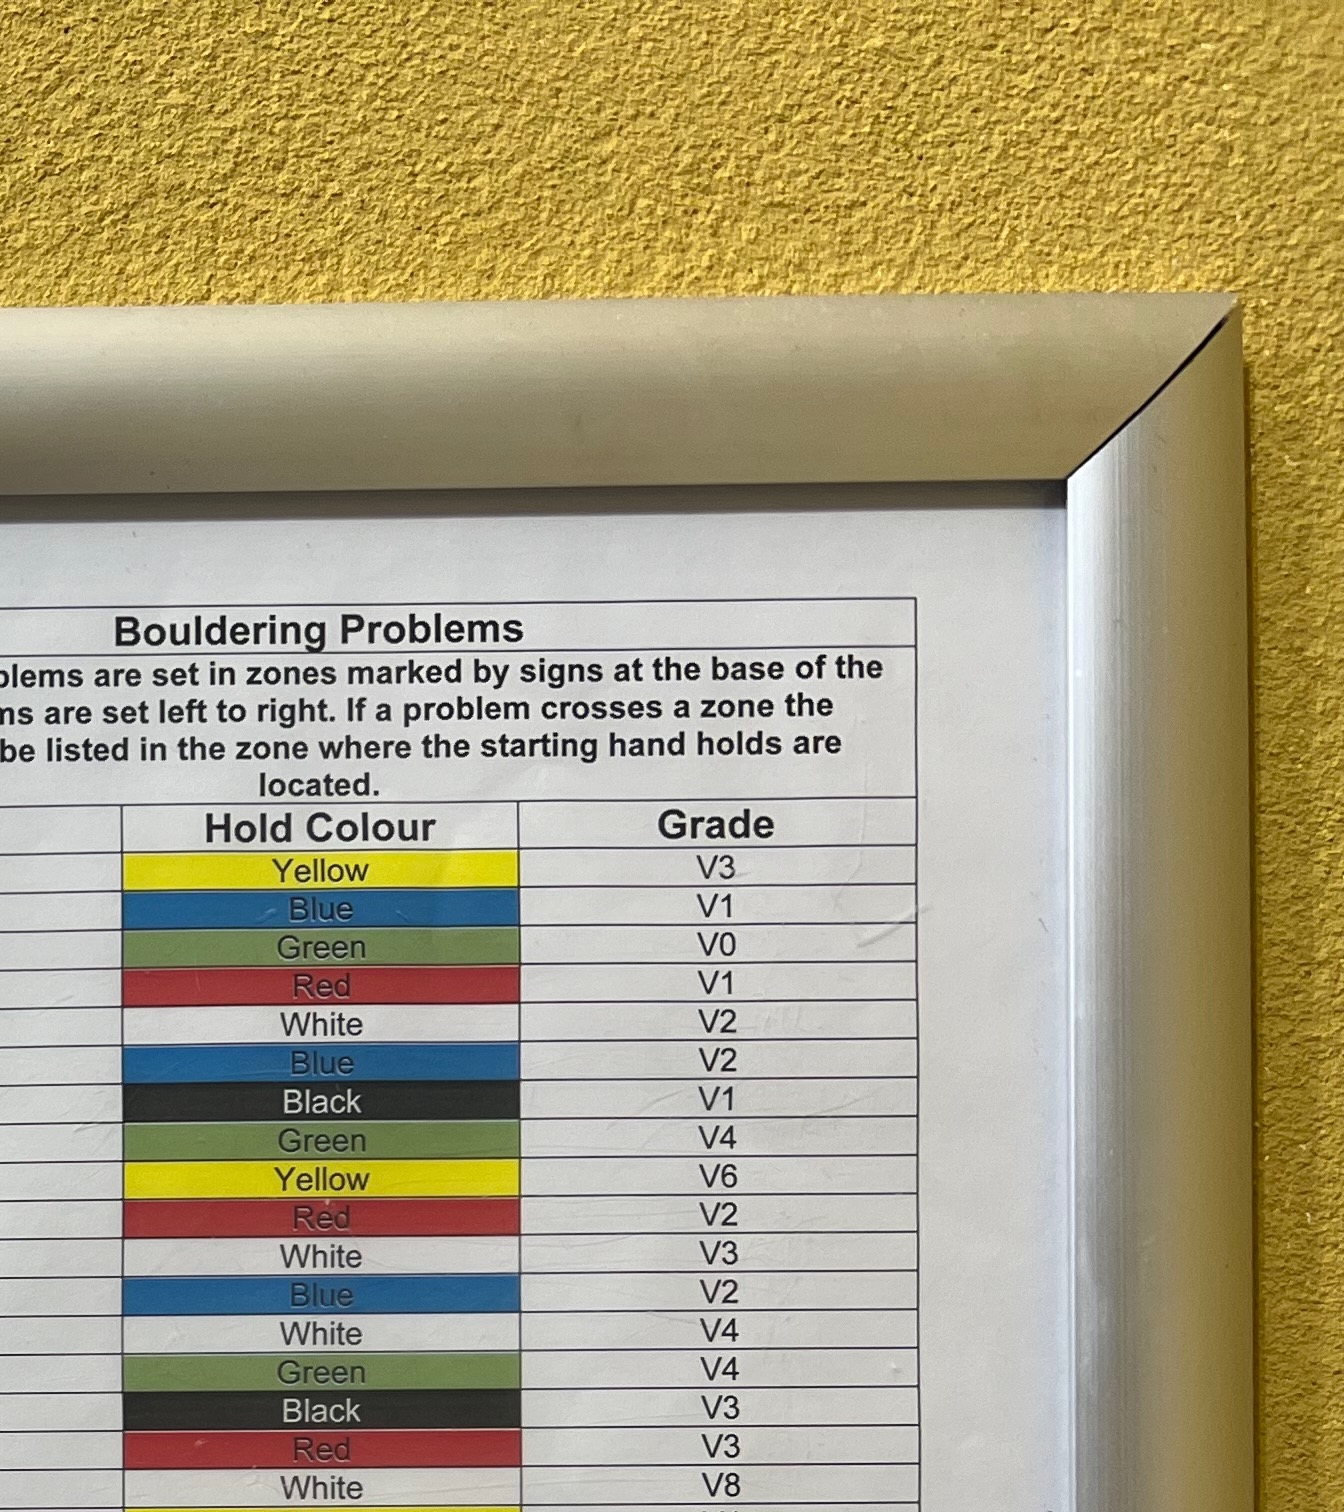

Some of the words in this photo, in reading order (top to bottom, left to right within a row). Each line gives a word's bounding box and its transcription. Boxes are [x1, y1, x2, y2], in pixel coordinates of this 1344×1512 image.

[115, 614, 326, 653] Bouldering
[341, 612, 524, 645] Problems
[94, 668, 142, 688] are
[152, 662, 200, 687] set
[209, 660, 236, 686] in
[245, 666, 337, 686] zones
[347, 657, 462, 685] marked
[473, 658, 510, 690] by
[519, 657, 604, 689] signs
[613, 657, 644, 682] at
[652, 656, 701, 682] the
[711, 655, 785, 681] base
[795, 653, 828, 680] of
[834, 653, 884, 680] the
[44, 705, 92, 725] are
[102, 700, 150, 725] set
[159, 698, 208, 724] left
[216, 699, 247, 723] to
[257, 697, 336, 729] right.
[347, 697, 367, 722] If
[375, 703, 392, 722] a
[403, 695, 530, 728] problem
[541, 699, 663, 720] crosses
[673, 699, 691, 719] a
[700, 698, 774, 718] zone
[784, 691, 834, 717] the
[0, 738, 36, 763] be
[46, 736, 129, 762] listed
[140, 736, 167, 762] in
[177, 735, 226, 761] the
[235, 740, 309, 760] zone
[318, 734, 412, 760] where
[421, 733, 470, 759] the
[480, 731, 598, 764] starting
[609, 730, 685, 757] hand
[697, 730, 782, 756] holds
[793, 735, 842, 755] are
[259, 771, 380, 797] located.
[205, 812, 292, 844] Hold
[306, 811, 437, 843] Colour
[658, 808, 775, 840] Grade
[271, 858, 370, 883] Yellow
[696, 854, 736, 880] V3
[277, 934, 366, 960] Green
[696, 931, 736, 957] V0
[283, 1088, 362, 1114] Black
[698, 1086, 733, 1111] V1
[293, 1204, 351, 1229] Red
[699, 1201, 738, 1227] V2
[277, 1359, 366, 1385] Green
[700, 1356, 740, 1381] V4
[279, 1475, 364, 1500] White
[701, 1472, 741, 1498] V8
